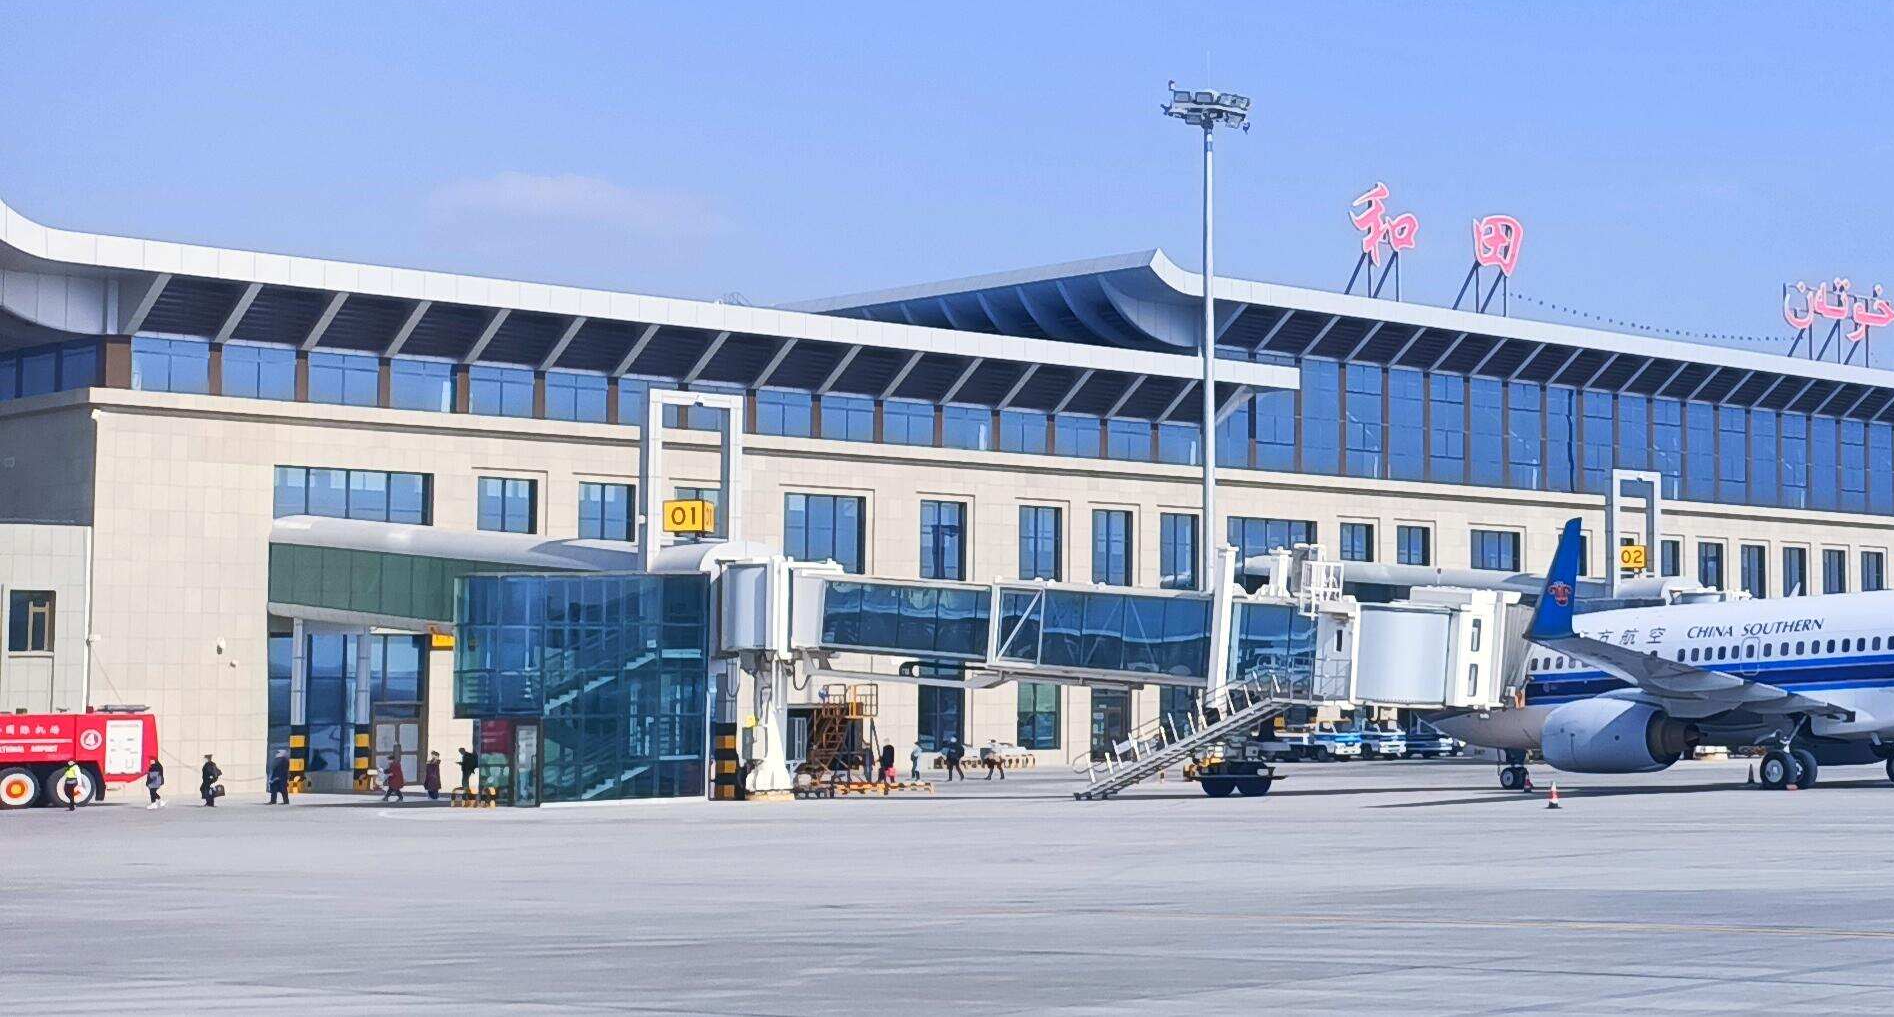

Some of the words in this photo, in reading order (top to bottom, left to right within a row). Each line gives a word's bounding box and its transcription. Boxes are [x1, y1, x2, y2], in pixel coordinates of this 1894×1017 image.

[1348, 181, 1525, 278] 和田
[671, 506, 696, 526] 01
[1620, 549, 1643, 564] 02
[1580, 626, 1667, 645] 方航空
[1687, 625, 1733, 639] CHINA
[1741, 617, 1825, 637] SOUTHERN
